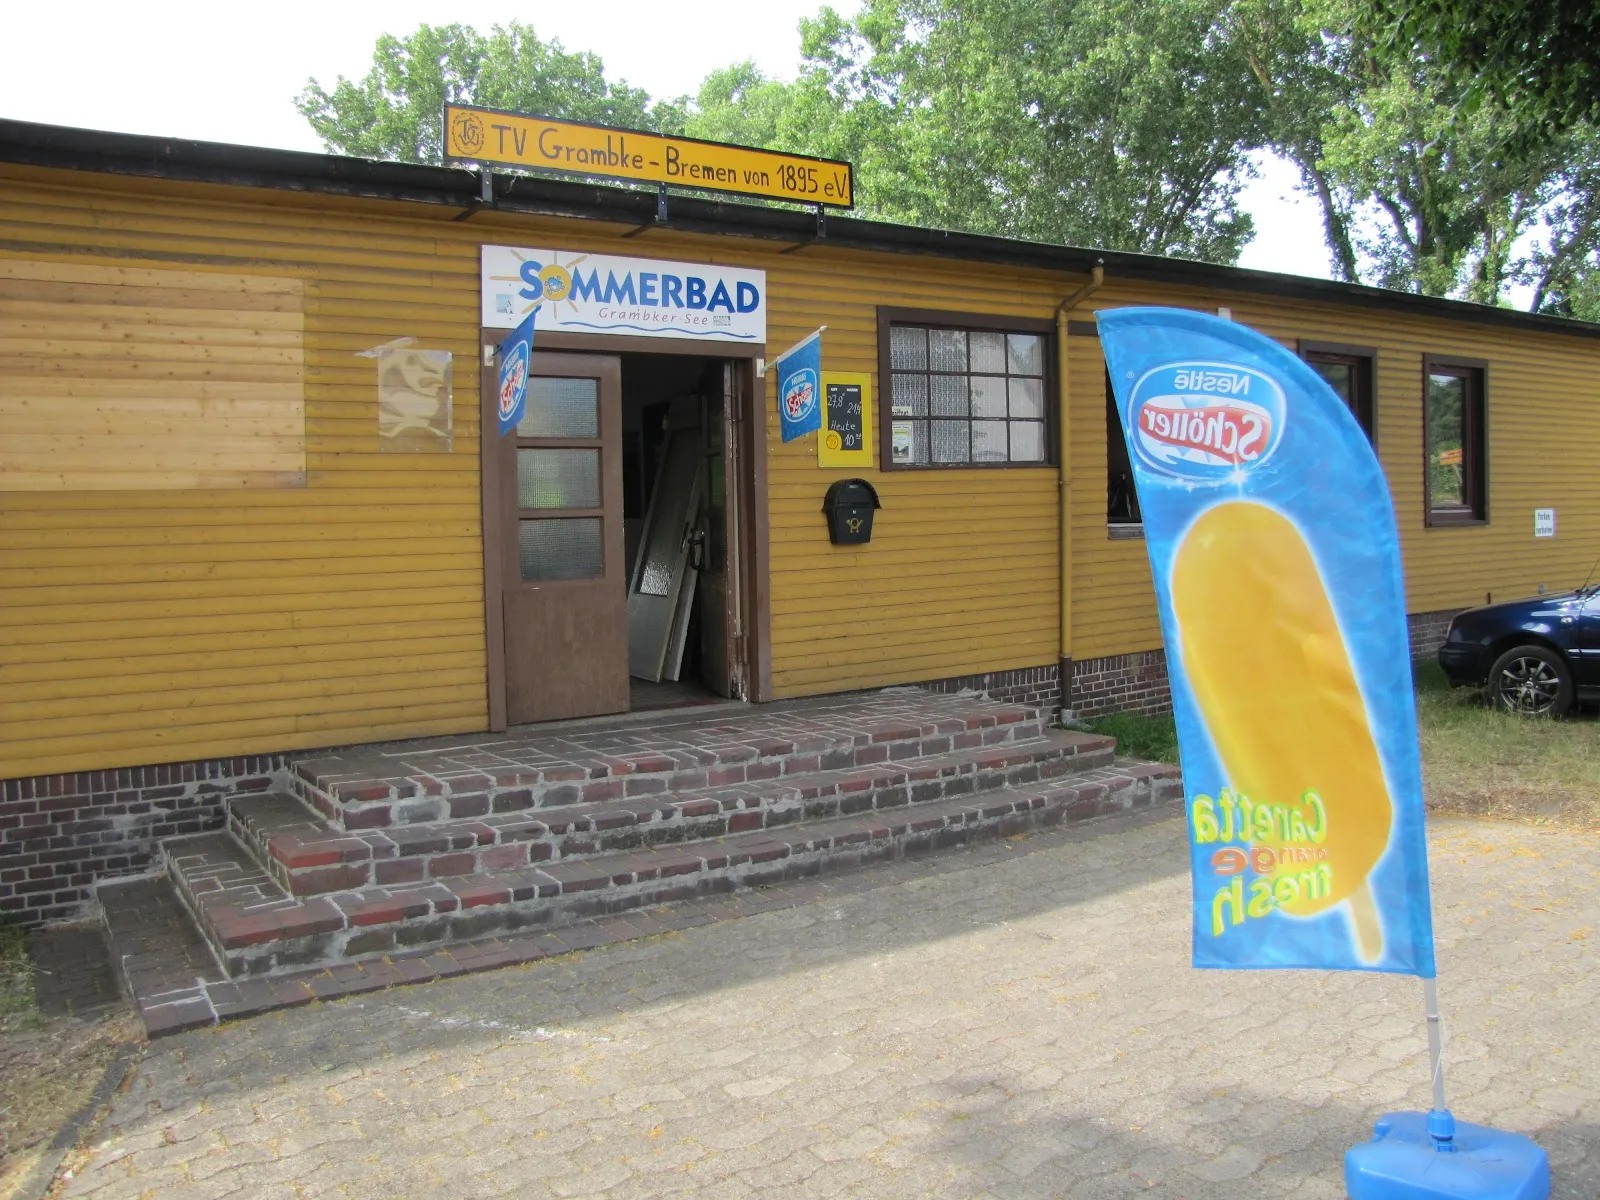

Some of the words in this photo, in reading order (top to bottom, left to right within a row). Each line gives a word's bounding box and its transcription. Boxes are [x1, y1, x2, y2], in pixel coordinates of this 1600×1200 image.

[491, 124, 527, 157] TV
[743, 170, 770, 187] von
[776, 164, 818, 194] 1895
[519, 260, 760, 314] SOMMERBAD
[830, 420, 856, 432] Heute
